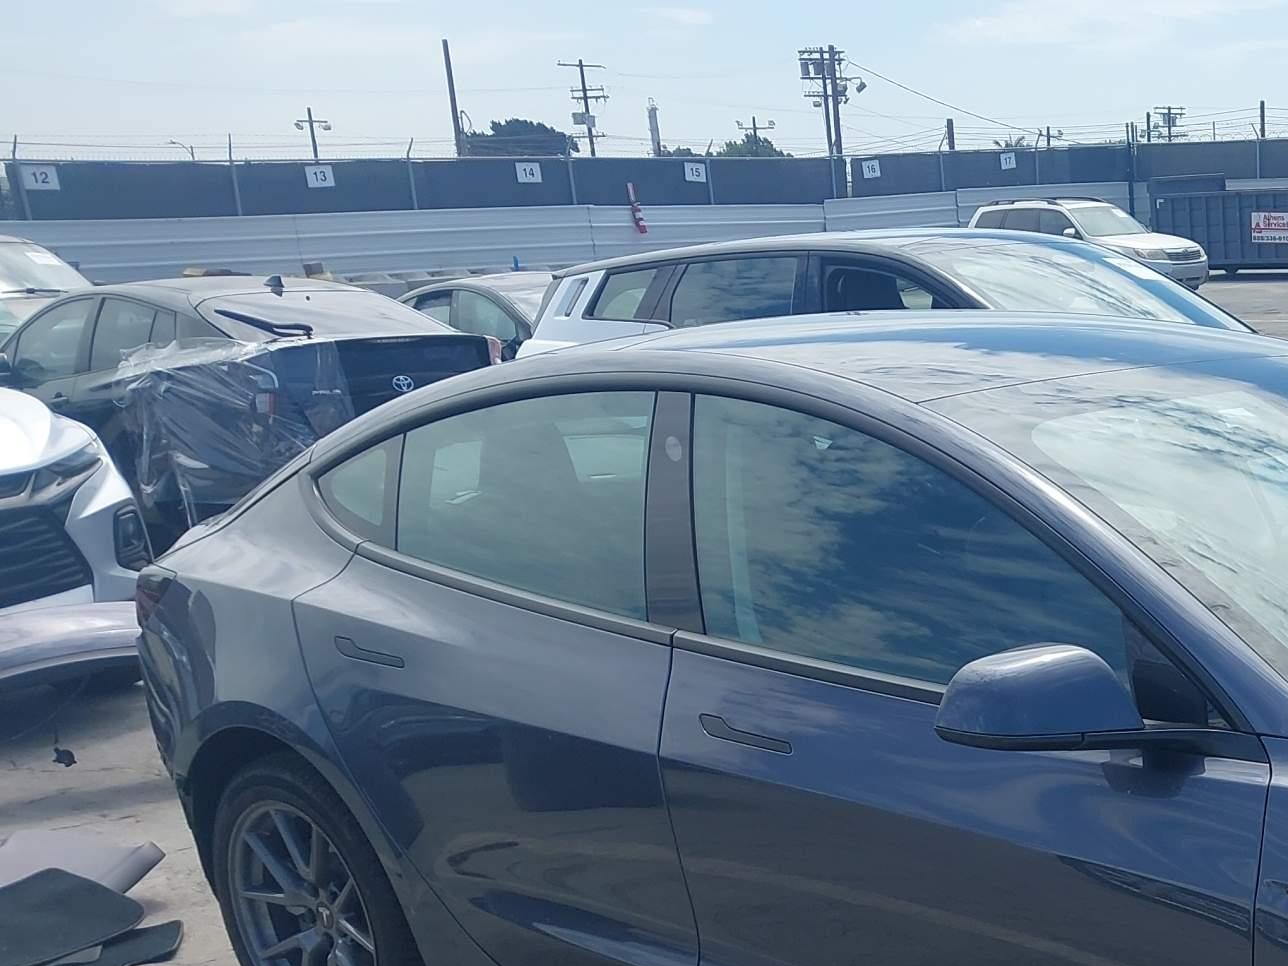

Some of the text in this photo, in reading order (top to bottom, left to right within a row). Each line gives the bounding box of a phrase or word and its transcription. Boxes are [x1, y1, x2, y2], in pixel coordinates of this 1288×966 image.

[1004, 156, 1012, 167] 17
[522, 167, 535, 178] 14
[690, 167, 701, 178] 15
[867, 164, 876, 174] 16
[32, 171, 49, 184] 12
[312, 170, 328, 183] 13
